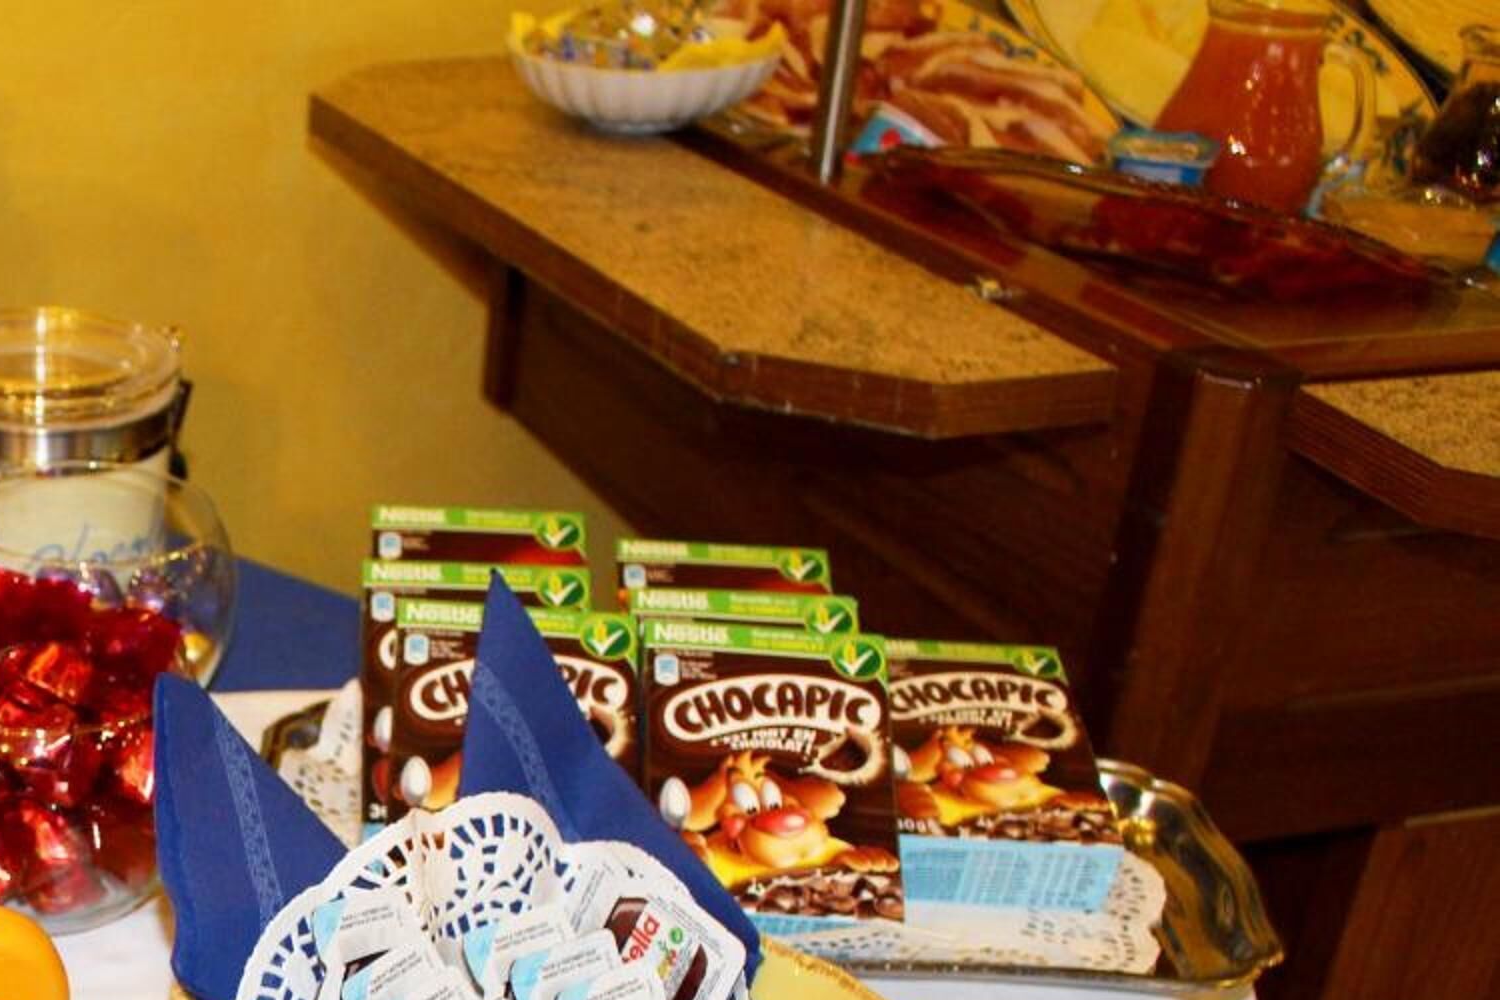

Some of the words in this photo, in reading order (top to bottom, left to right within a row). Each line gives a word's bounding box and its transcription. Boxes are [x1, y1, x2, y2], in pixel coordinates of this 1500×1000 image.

[420, 663, 620, 713] CHPIC
[673, 681, 873, 735] CHOCAPIC
[622, 914, 661, 964] ella
